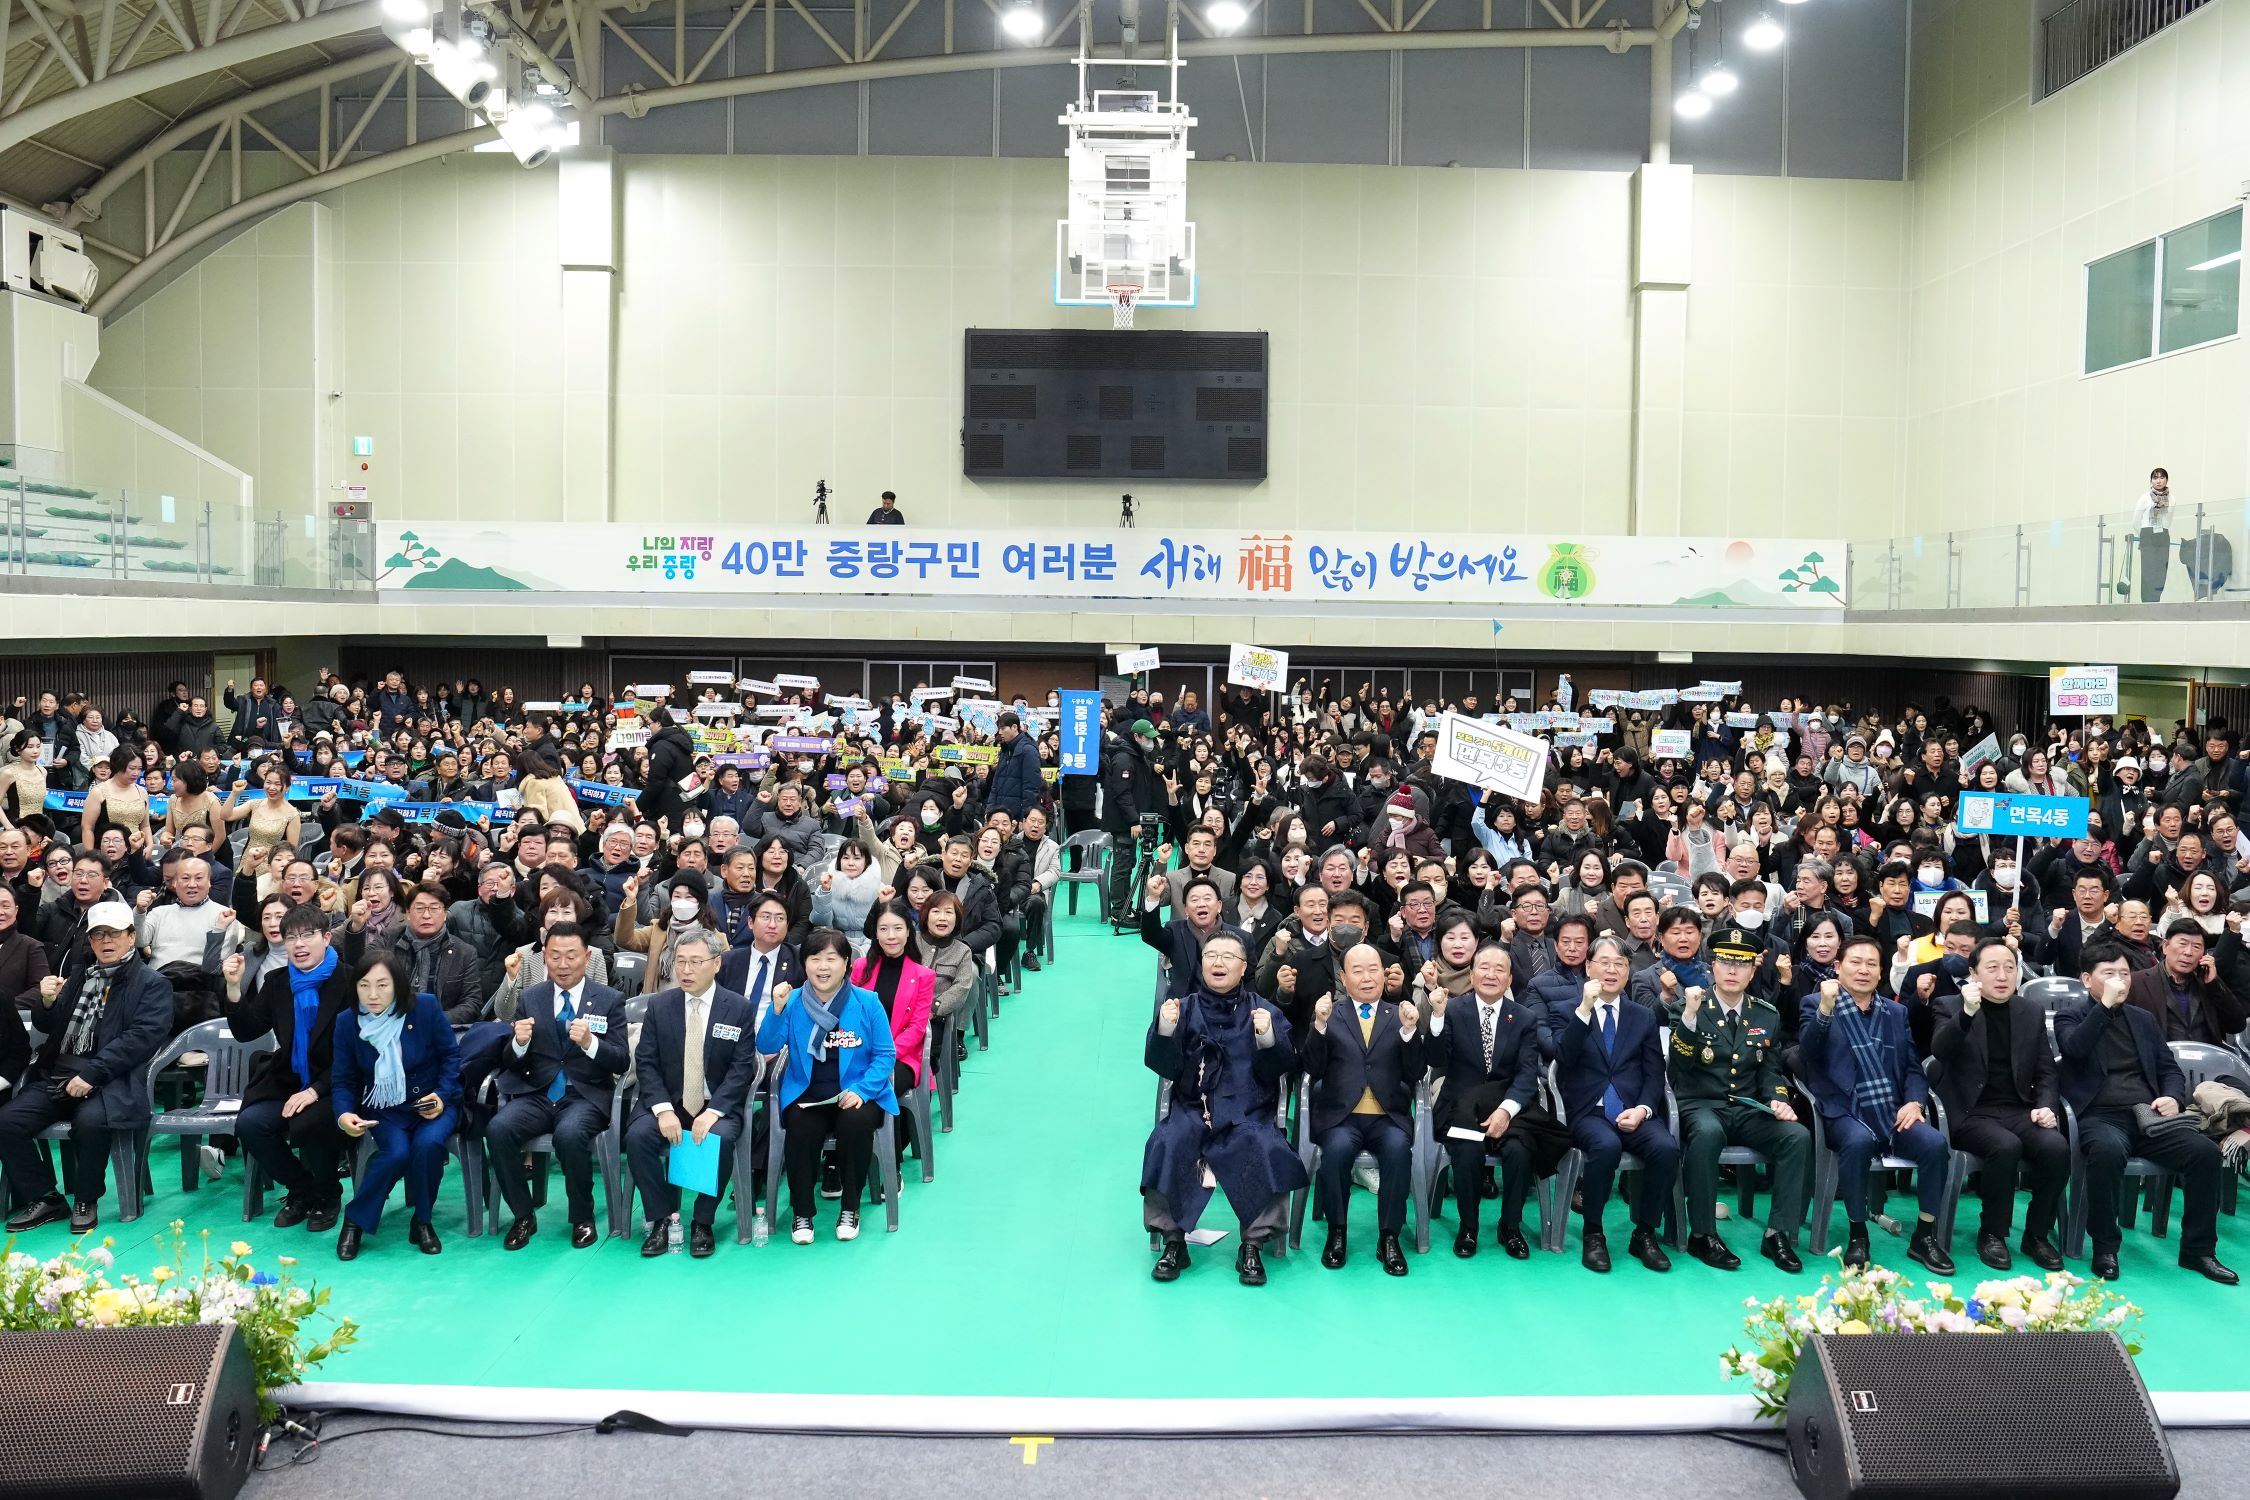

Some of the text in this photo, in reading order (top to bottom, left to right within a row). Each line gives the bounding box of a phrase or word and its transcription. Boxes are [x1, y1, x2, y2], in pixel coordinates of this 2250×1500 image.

[626, 555, 697, 581] 우리 중랑
[643, 537, 714, 582] 나의 자랑
[721, 534, 1529, 593] 40만 중랑구민 여러분 새해 福 많이 받으세요
[2062, 677, 2108, 690] 함께하면
[2057, 693, 2089, 707] 면목2
[1456, 742, 1529, 780] 면목5동
[341, 782, 371, 799] 묵1동
[581, 788, 606, 800] 묵직하게
[394, 808, 417, 819] 직하게
[2009, 805, 2070, 827] 면목4동
